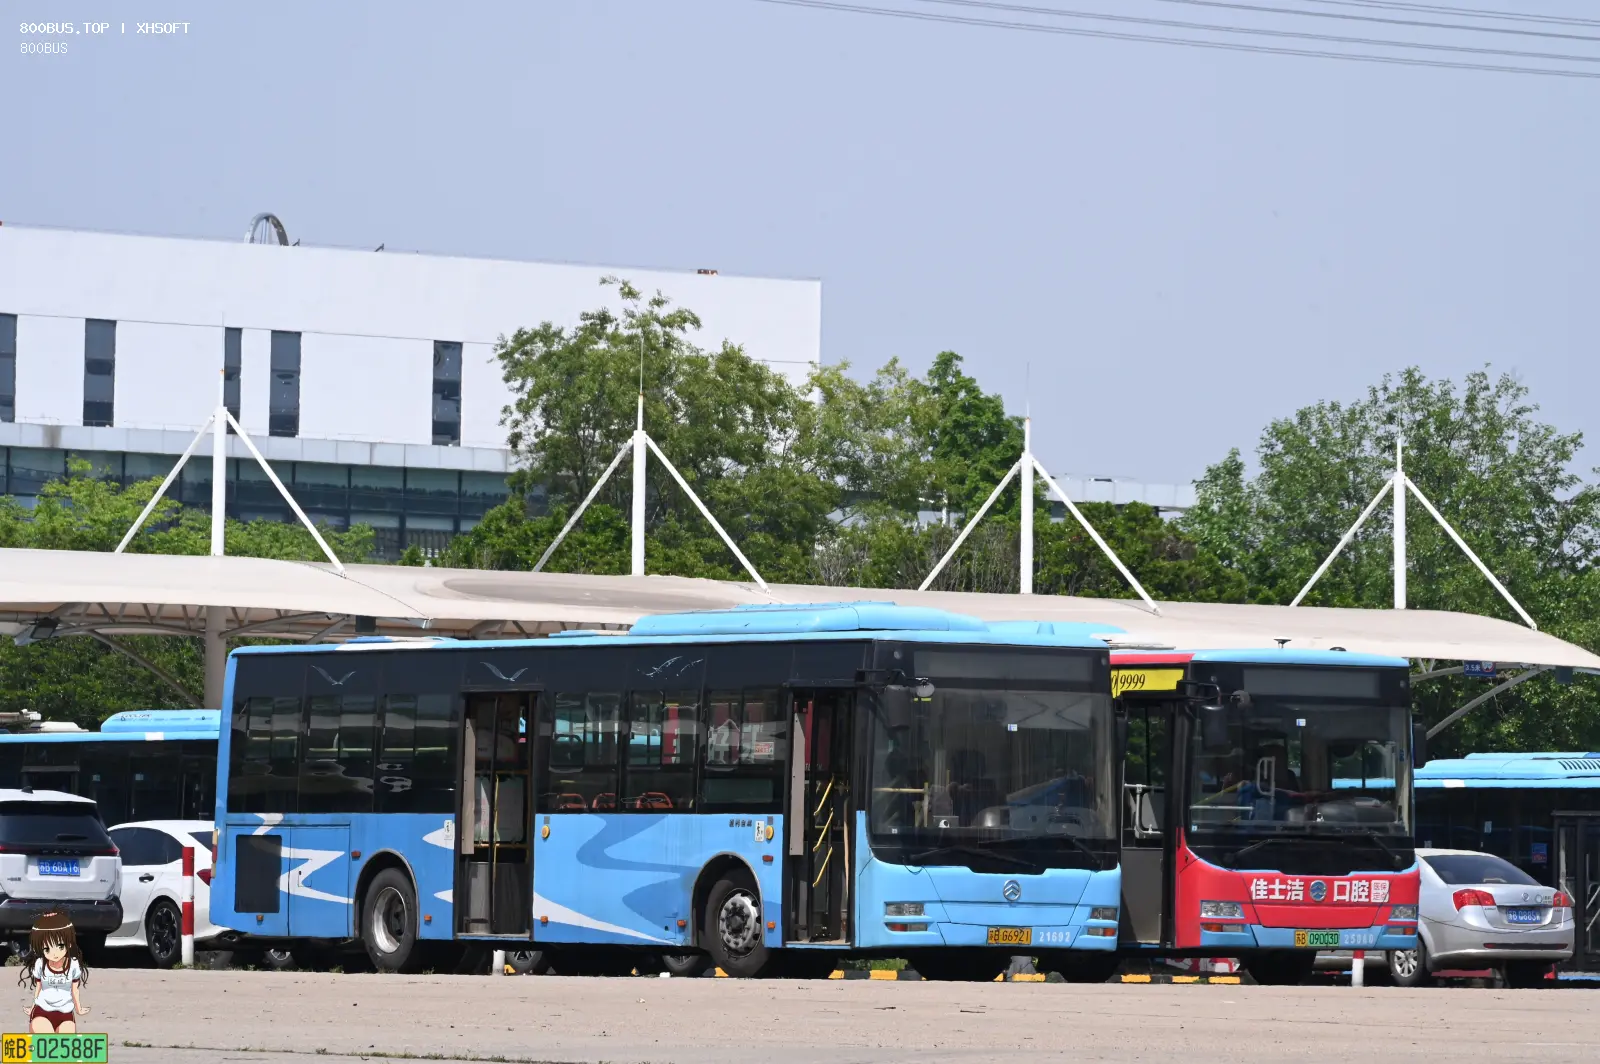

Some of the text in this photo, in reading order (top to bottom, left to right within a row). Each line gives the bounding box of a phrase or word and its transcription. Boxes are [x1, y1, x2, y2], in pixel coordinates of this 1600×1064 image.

[1250, 878, 1370, 903] 佳士洁 口腔
[1039, 931, 1071, 943] 21692
